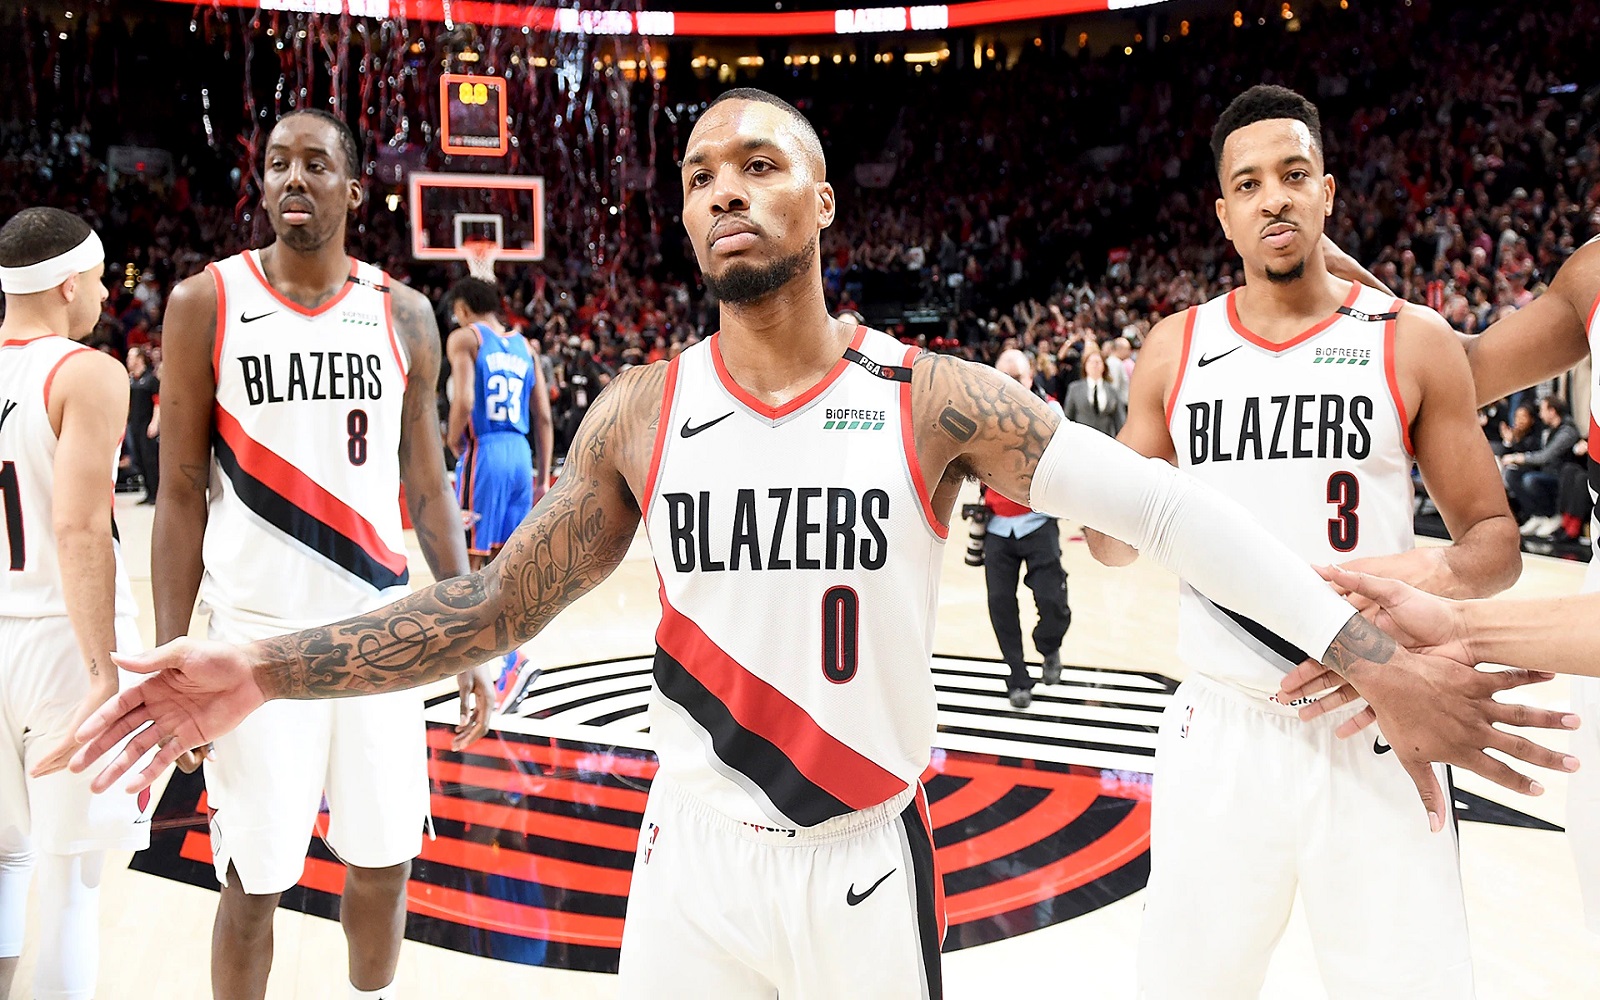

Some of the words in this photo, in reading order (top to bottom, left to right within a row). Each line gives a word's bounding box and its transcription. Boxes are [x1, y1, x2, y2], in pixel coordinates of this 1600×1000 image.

[236, 352, 382, 405] BLAZERS
[859, 356, 880, 375] PGA
[486, 375, 524, 424] 23
[1186, 394, 1373, 465] BLAZERS
[347, 409, 368, 466] 8
[662, 487, 890, 573] BLAZERS
[1327, 470, 1360, 552] 3
[821, 585, 859, 684] 0
